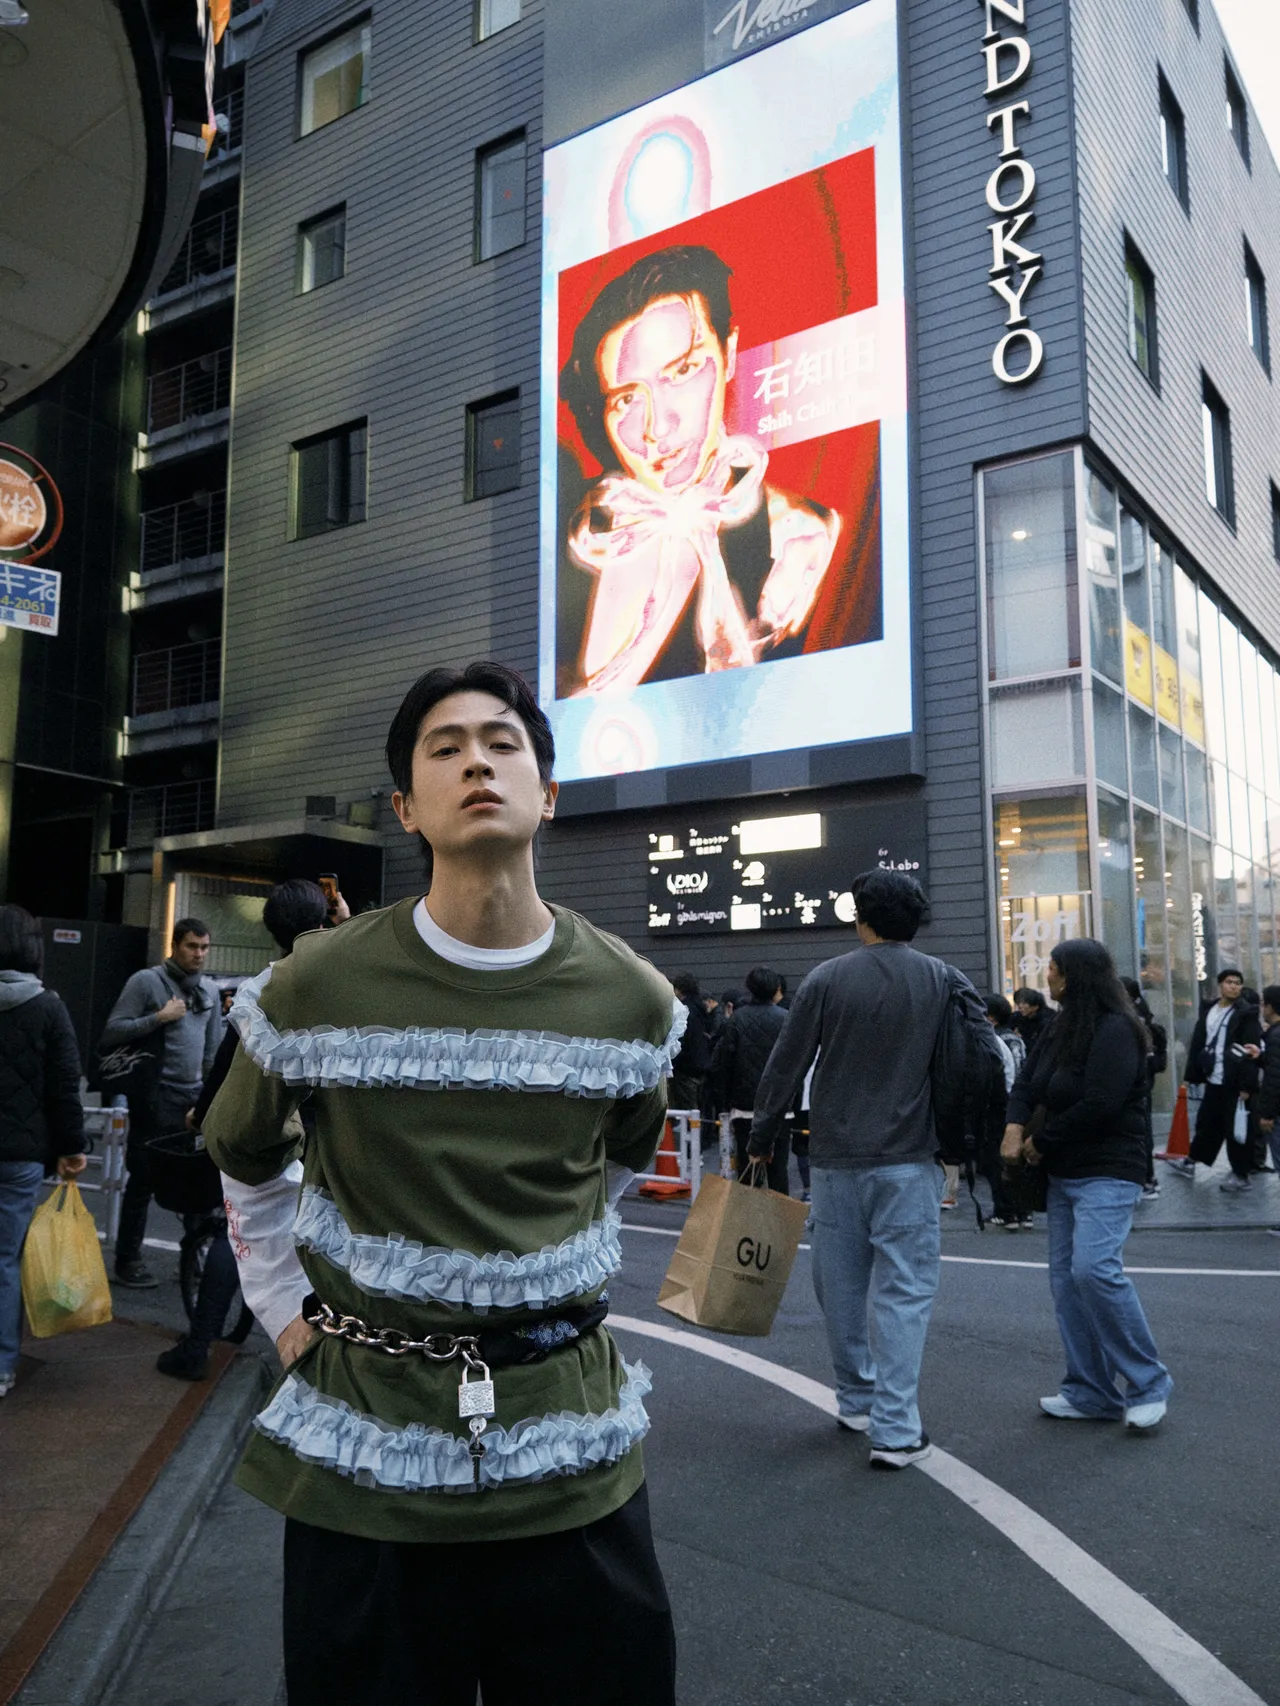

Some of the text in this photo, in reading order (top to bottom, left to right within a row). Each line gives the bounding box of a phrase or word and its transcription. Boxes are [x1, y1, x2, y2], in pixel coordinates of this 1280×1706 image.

[985, 100, 1043, 383] TOKYO
[757, 409, 792, 434] Shih
[674, 873, 701, 888] DIO
[648, 913, 671, 927] Zoff
[1011, 910, 1079, 943] Zoff
[737, 1236, 771, 1271] GU
